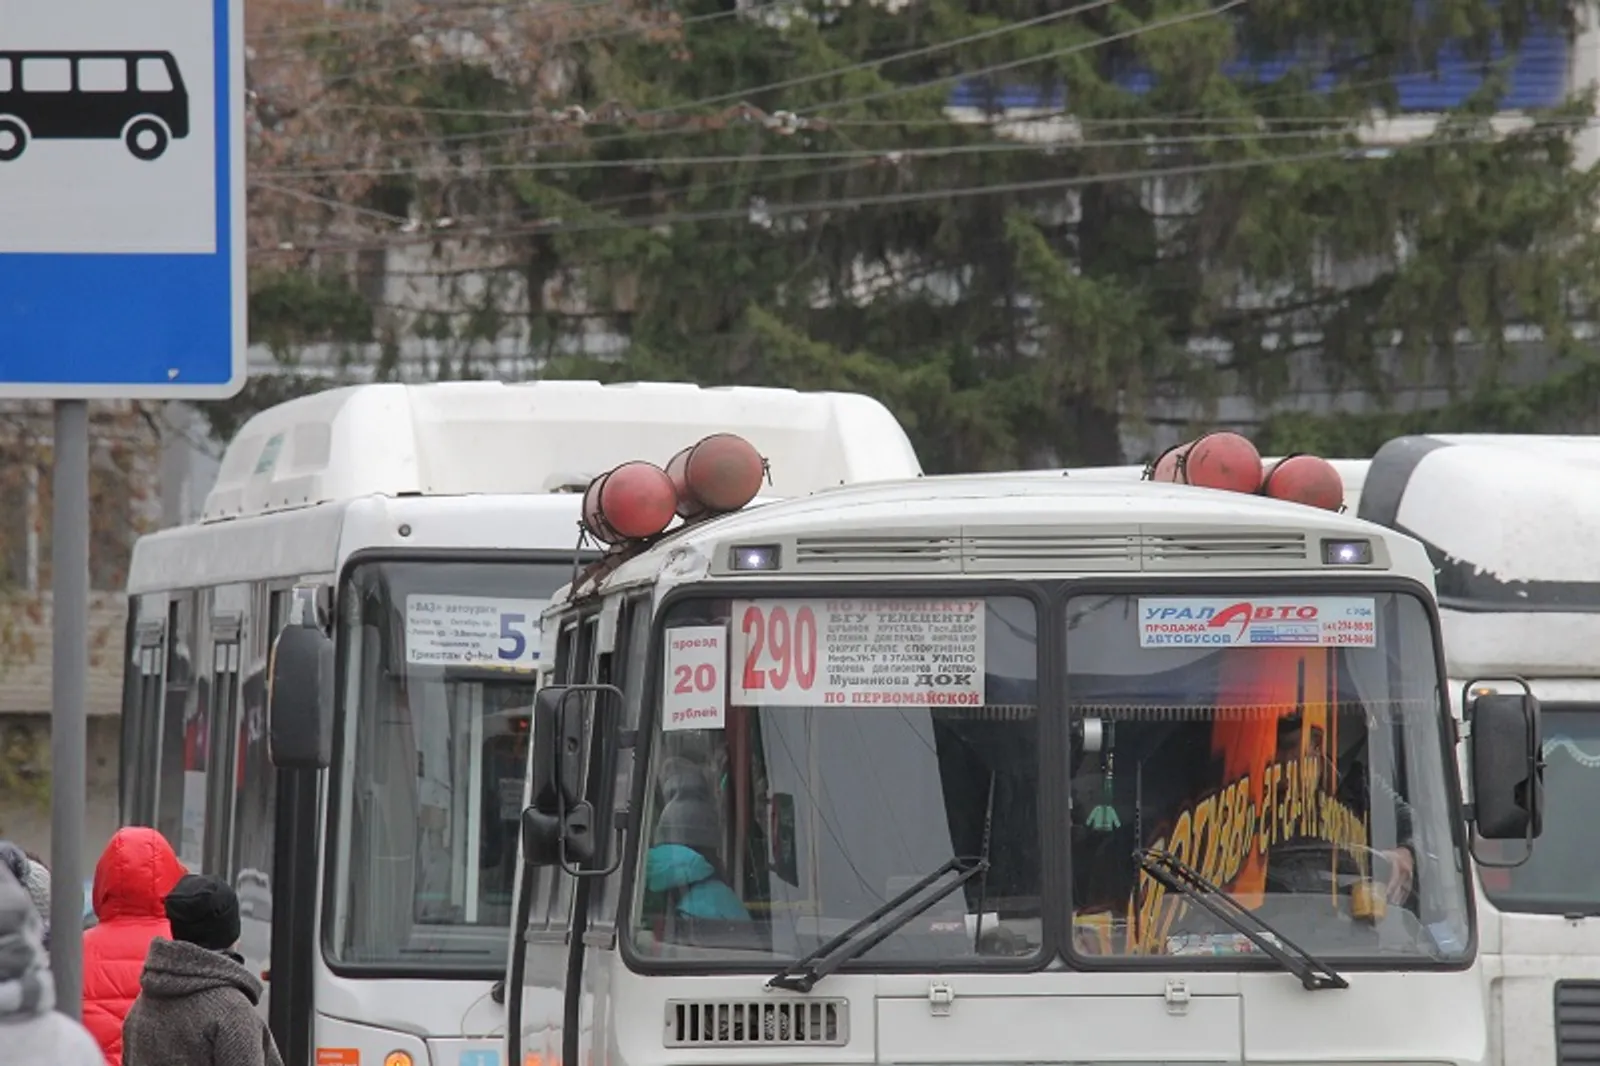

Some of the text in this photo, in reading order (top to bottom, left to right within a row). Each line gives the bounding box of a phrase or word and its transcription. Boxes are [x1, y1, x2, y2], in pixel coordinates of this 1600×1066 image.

[829, 613, 975, 623] БГУ ТЕЛЕЦЕНТР
[1144, 623, 1206, 633] ПРОДАЖА
[498, 613, 541, 660] 5
[1146, 634, 1232, 644] АВТОБУСОВ
[672, 638, 718, 651] проезд
[742, 605, 817, 690] 290
[904, 644, 976, 653] СПОРТИВНАЯ
[932, 653, 976, 663] УМПО
[673, 663, 717, 695] 20
[830, 674, 971, 688] Мушникова ДОК
[824, 690, 979, 704] ПО ПЕРВОМАЙСКОЙ
[672, 706, 718, 723] рублей
